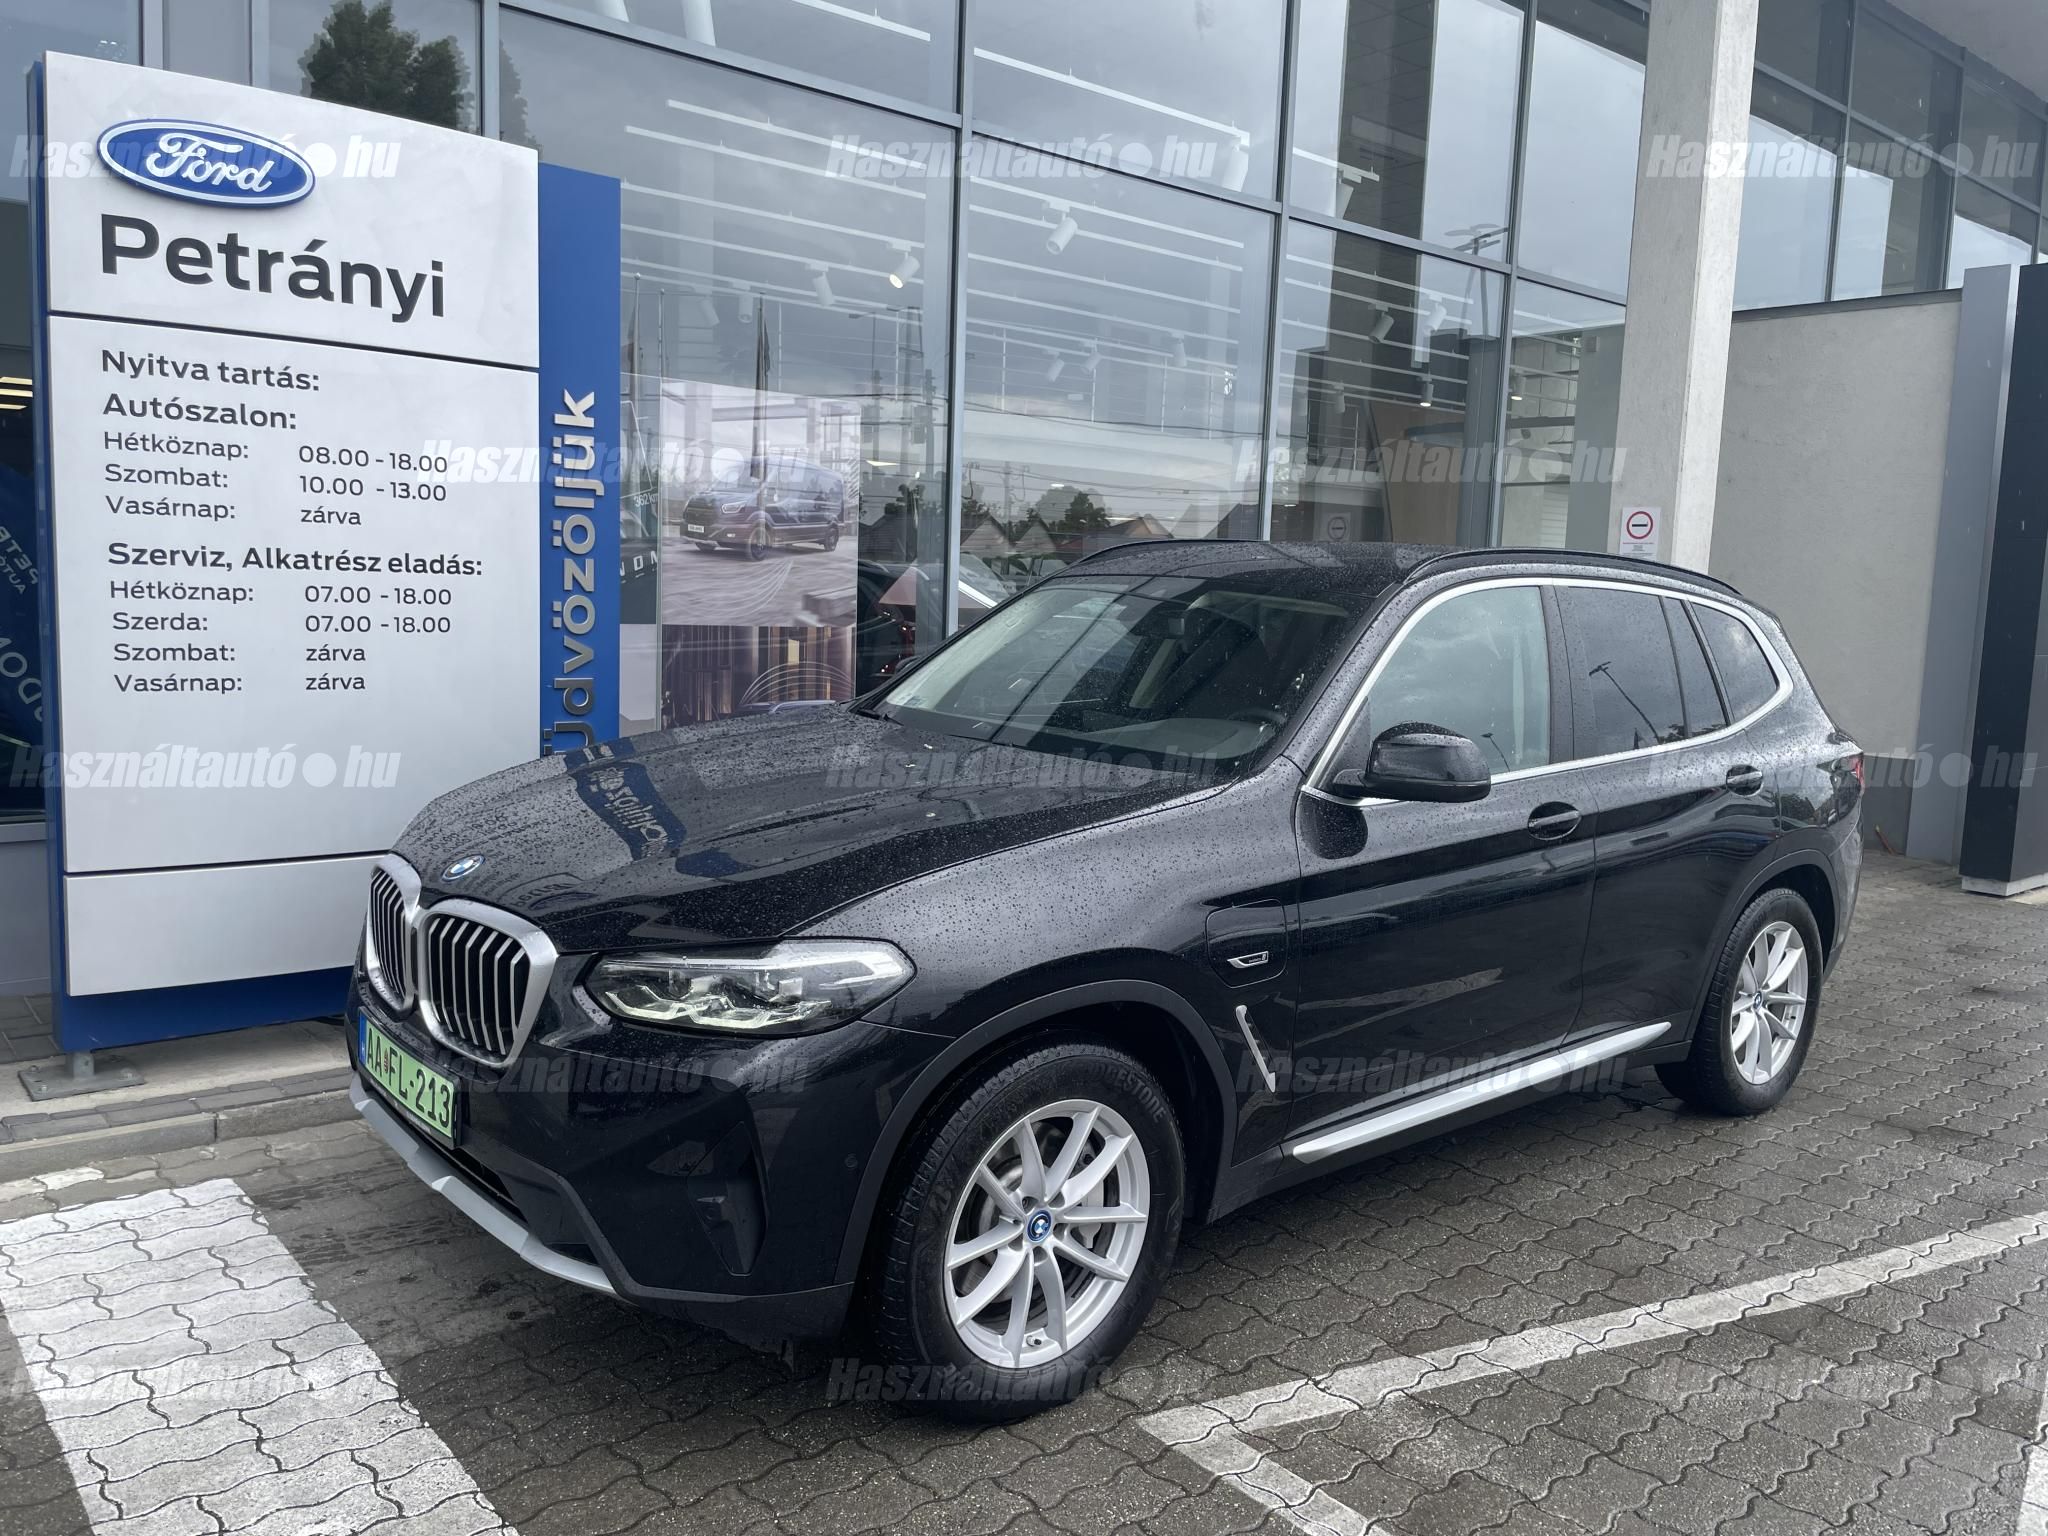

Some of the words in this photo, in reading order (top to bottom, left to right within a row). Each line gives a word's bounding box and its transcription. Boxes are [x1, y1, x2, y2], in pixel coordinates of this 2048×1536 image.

[144, 131, 276, 195] Ford
[100, 212, 445, 324] Petrányi
[101, 349, 210, 382] Nyitva
[216, 361, 320, 392] tartás:
[102, 392, 298, 430] Autószalon:
[104, 431, 249, 462] Hétköznap:
[298, 445, 370, 468] 08.00
[388, 452, 448, 473] 18.00
[104, 463, 228, 488] Szombat:
[299, 475, 364, 497] 10.00
[389, 481, 447, 502] 13.00
[105, 495, 236, 522] Vasárnap:
[300, 505, 362, 526] zárva
[108, 542, 233, 572] Szerviz,
[241, 547, 382, 573] Alkatrész
[387, 552, 482, 576] eladás:
[110, 580, 254, 605] Hétköznap:
[304, 585, 371, 604] 07.00
[393, 587, 452, 606] 18.00
[112, 611, 208, 631] Szerda:
[305, 614, 372, 633] 07.00
[393, 616, 451, 633] 18.00
[113, 642, 235, 662] Szombat:
[305, 643, 366, 662] zárva
[113, 673, 242, 695] Vasárnap:
[305, 672, 366, 691] zárva
